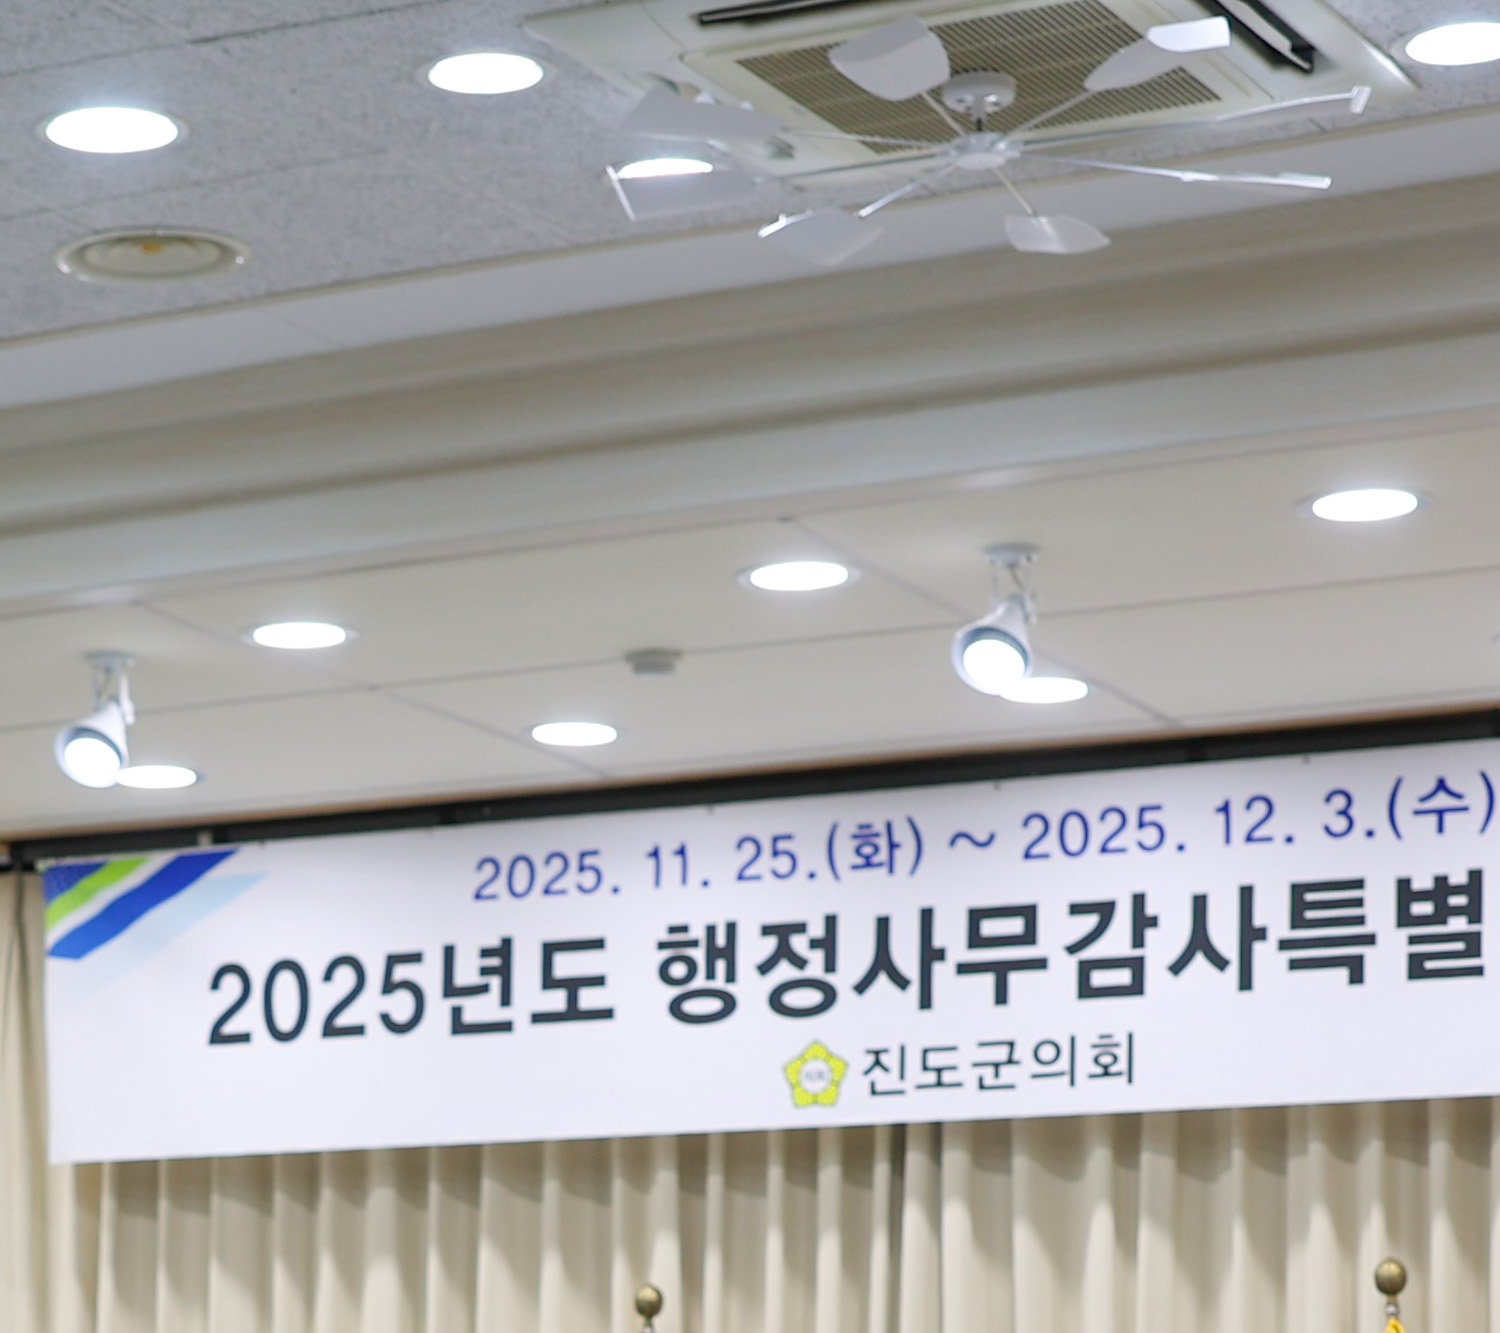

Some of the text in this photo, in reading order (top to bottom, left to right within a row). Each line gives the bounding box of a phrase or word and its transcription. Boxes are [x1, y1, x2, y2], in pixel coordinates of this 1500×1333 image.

[472, 848, 621, 902] 2025.
[645, 842, 711, 888] 11.
[734, 815, 925, 883] 25.(화)
[1020, 803, 1187, 861] 2025.
[1214, 793, 1295, 846] 12.
[1322, 768, 1497, 841] 3.(수)
[206, 934, 616, 1047] 2025년도
[861, 1031, 1136, 1098] 진도군의회
